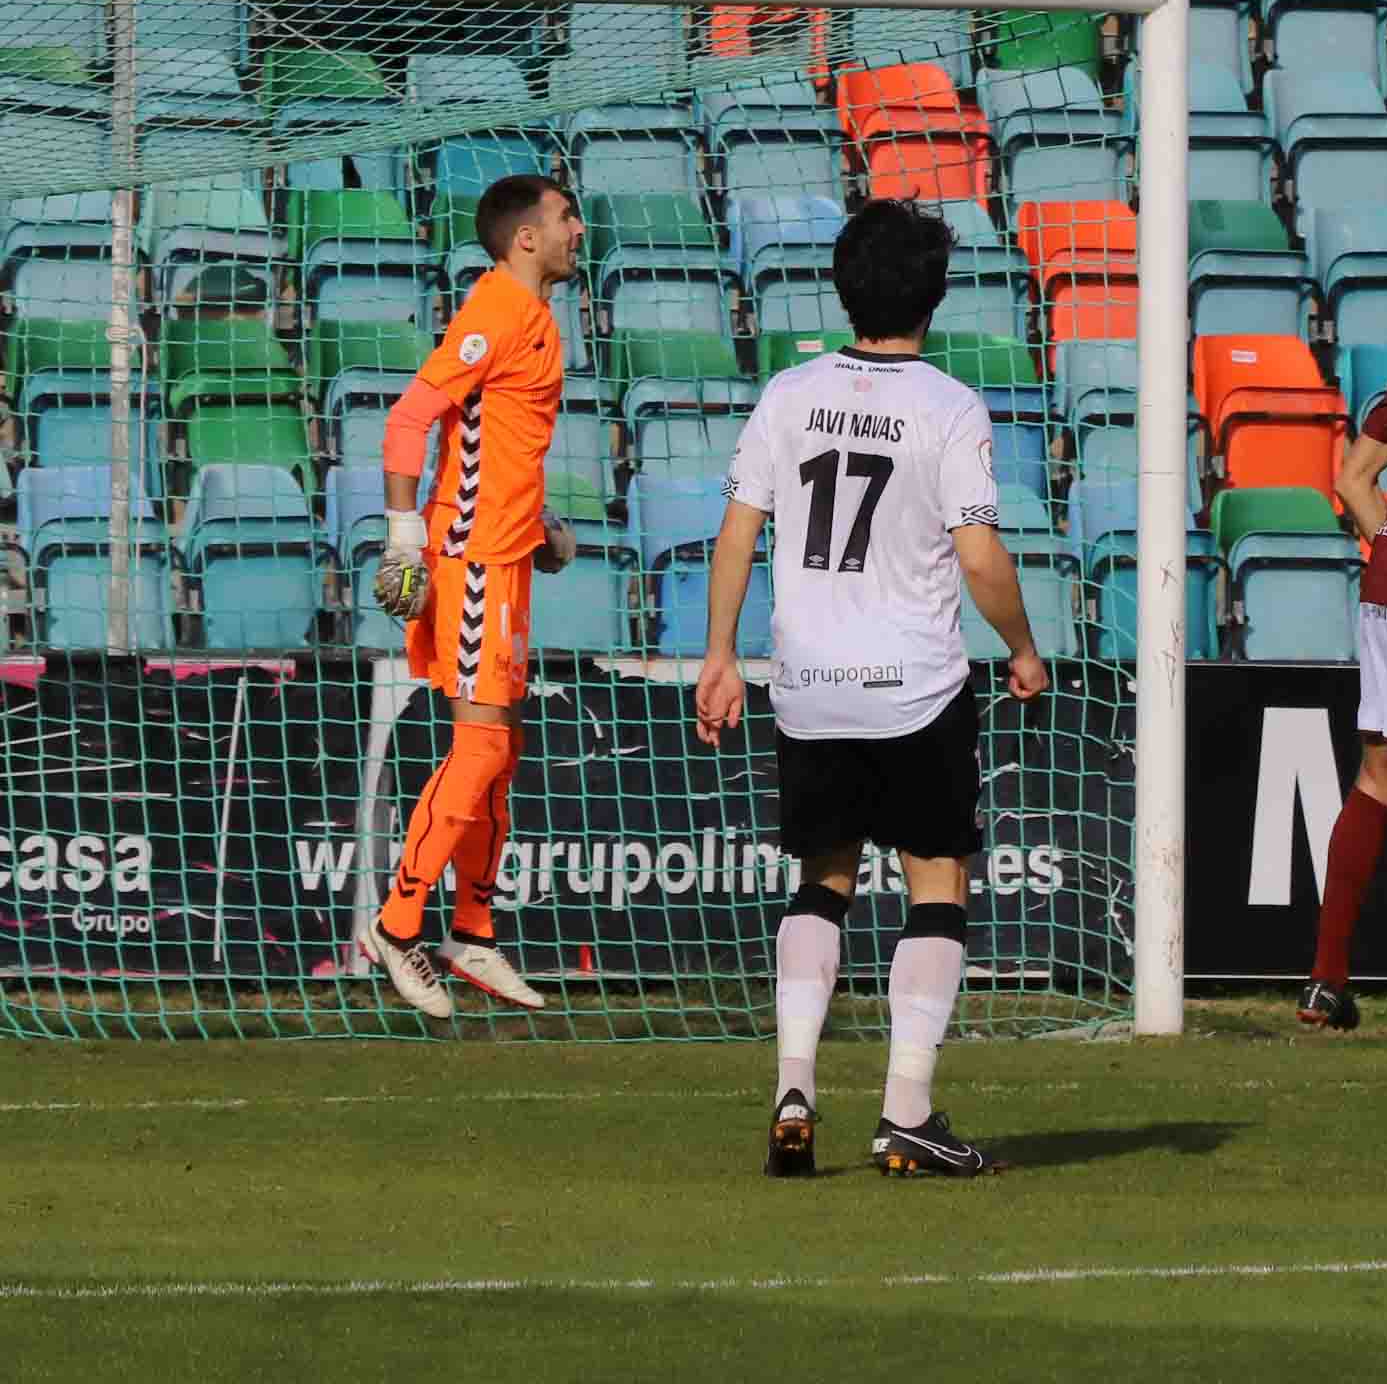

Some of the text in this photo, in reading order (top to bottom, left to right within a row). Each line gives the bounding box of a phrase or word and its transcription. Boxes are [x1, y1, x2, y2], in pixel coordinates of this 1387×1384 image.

[805, 408, 905, 443] JAVI NAVAS
[798, 448, 895, 573] 17
[799, 657, 904, 687] gruponani
[0, 834, 152, 892] asa
[71, 902, 151, 938] Grupo
